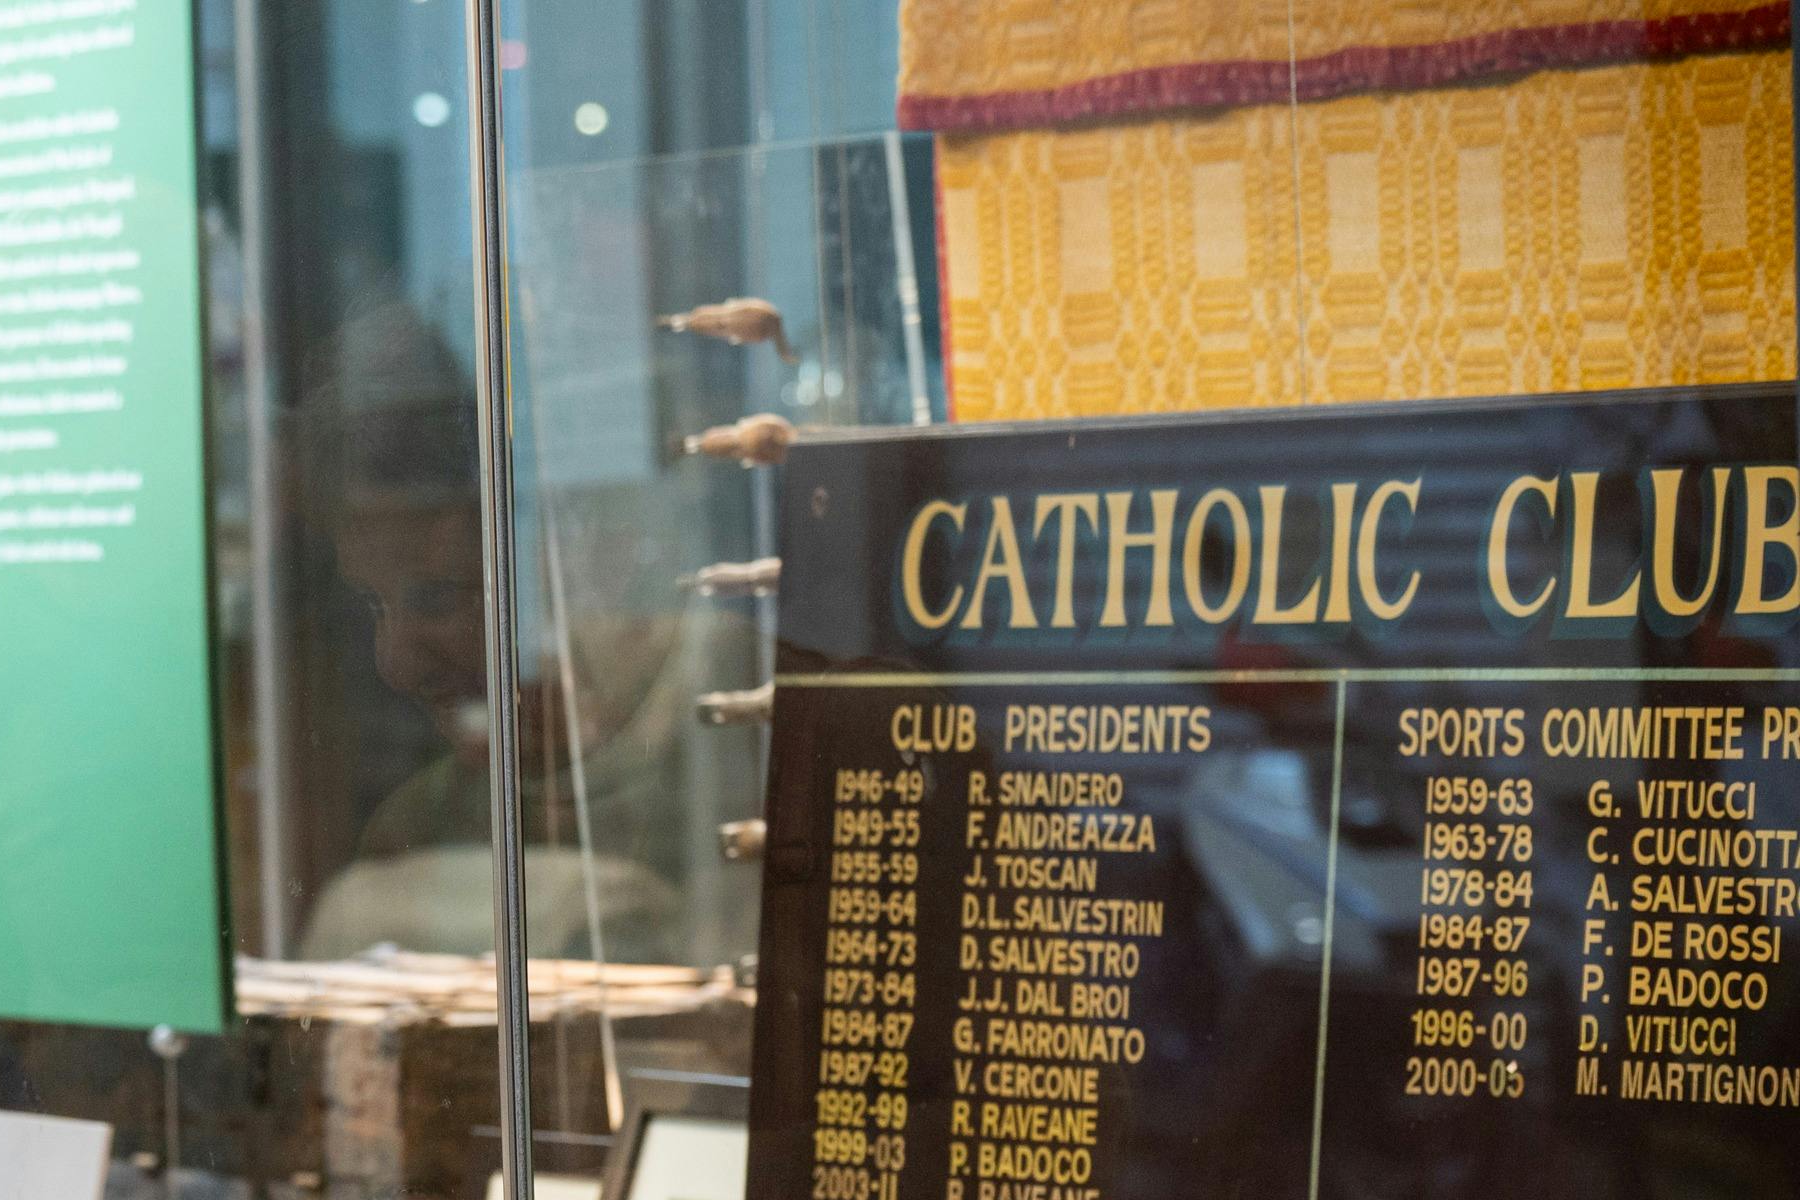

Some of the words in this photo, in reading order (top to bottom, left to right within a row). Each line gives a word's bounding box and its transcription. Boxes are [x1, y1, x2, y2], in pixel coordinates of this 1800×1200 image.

[901, 476, 1423, 630] CATHOLIC
[1487, 465, 1800, 617] CLUB
[892, 706, 977, 752] CLUB
[1005, 705, 1211, 753] PRESIDENTS
[1399, 708, 1525, 758] SPORTS
[1542, 707, 1744, 760] COMMITTEE
[1762, 706, 1800, 759] PR
[834, 769, 924, 804] 1946-49
[968, 771, 992, 806] R.
[999, 772, 1123, 807] SNAIDERO
[1426, 778, 1533, 816] 1959-63
[1589, 780, 1622, 818] G.
[1638, 780, 1756, 820] VITUCCI
[832, 809, 921, 847] 1949-55
[966, 812, 989, 850] F.
[995, 813, 1155, 853] ANDREAZZA
[1424, 823, 1533, 862] 1963-78
[1588, 828, 1620, 865] C.
[1632, 828, 1800, 869] CUCINOTT
[831, 852, 919, 885] 1955-59
[964, 855, 987, 888] J.
[995, 855, 1097, 892] TOSCAN
[1422, 869, 1533, 908] 1978-84
[1586, 874, 1619, 911] A.
[1631, 875, 1800, 917] SALVESTR
[828, 889, 917, 926] 1959-64
[1013, 897, 1164, 937] SALVESTRIN
[826, 930, 916, 968] 1964-73
[960, 934, 984, 971] D.
[989, 936, 1139, 979] SALVESTRO
[1420, 914, 1531, 952] 1984-87
[1584, 919, 1614, 956] F.
[1631, 922, 1673, 958] DE
[1685, 923, 1781, 963] ROSSI
[824, 969, 916, 1007] 1973-84
[1015, 980, 1065, 1016] DAL
[1070, 983, 1129, 1019] BROI
[1417, 957, 1529, 997] 1987-96
[1582, 964, 1610, 1004] P.
[1629, 967, 1768, 1010] BADOCO
[821, 1009, 914, 1047] 1984-87
[953, 1019, 981, 1055] G.
[986, 1020, 1145, 1063] FARRONATO
[1411, 1009, 1527, 1050] 1996-00
[1578, 1015, 1609, 1053] D.
[1626, 1015, 1737, 1056] VITUCCI
[819, 1051, 908, 1088] 1987-92
[954, 1059, 976, 1095] V.
[984, 1063, 1099, 1102] CERCONE
[1576, 1057, 1608, 1096] M.
[816, 1090, 907, 1129] 1992-99
[951, 1100, 974, 1137] R.
[981, 1104, 1097, 1145] RAVEANE
[814, 1128, 905, 1171] 1999-03
[949, 1142, 971, 1177] P.
[978, 1145, 1092, 1185] BADOCO
